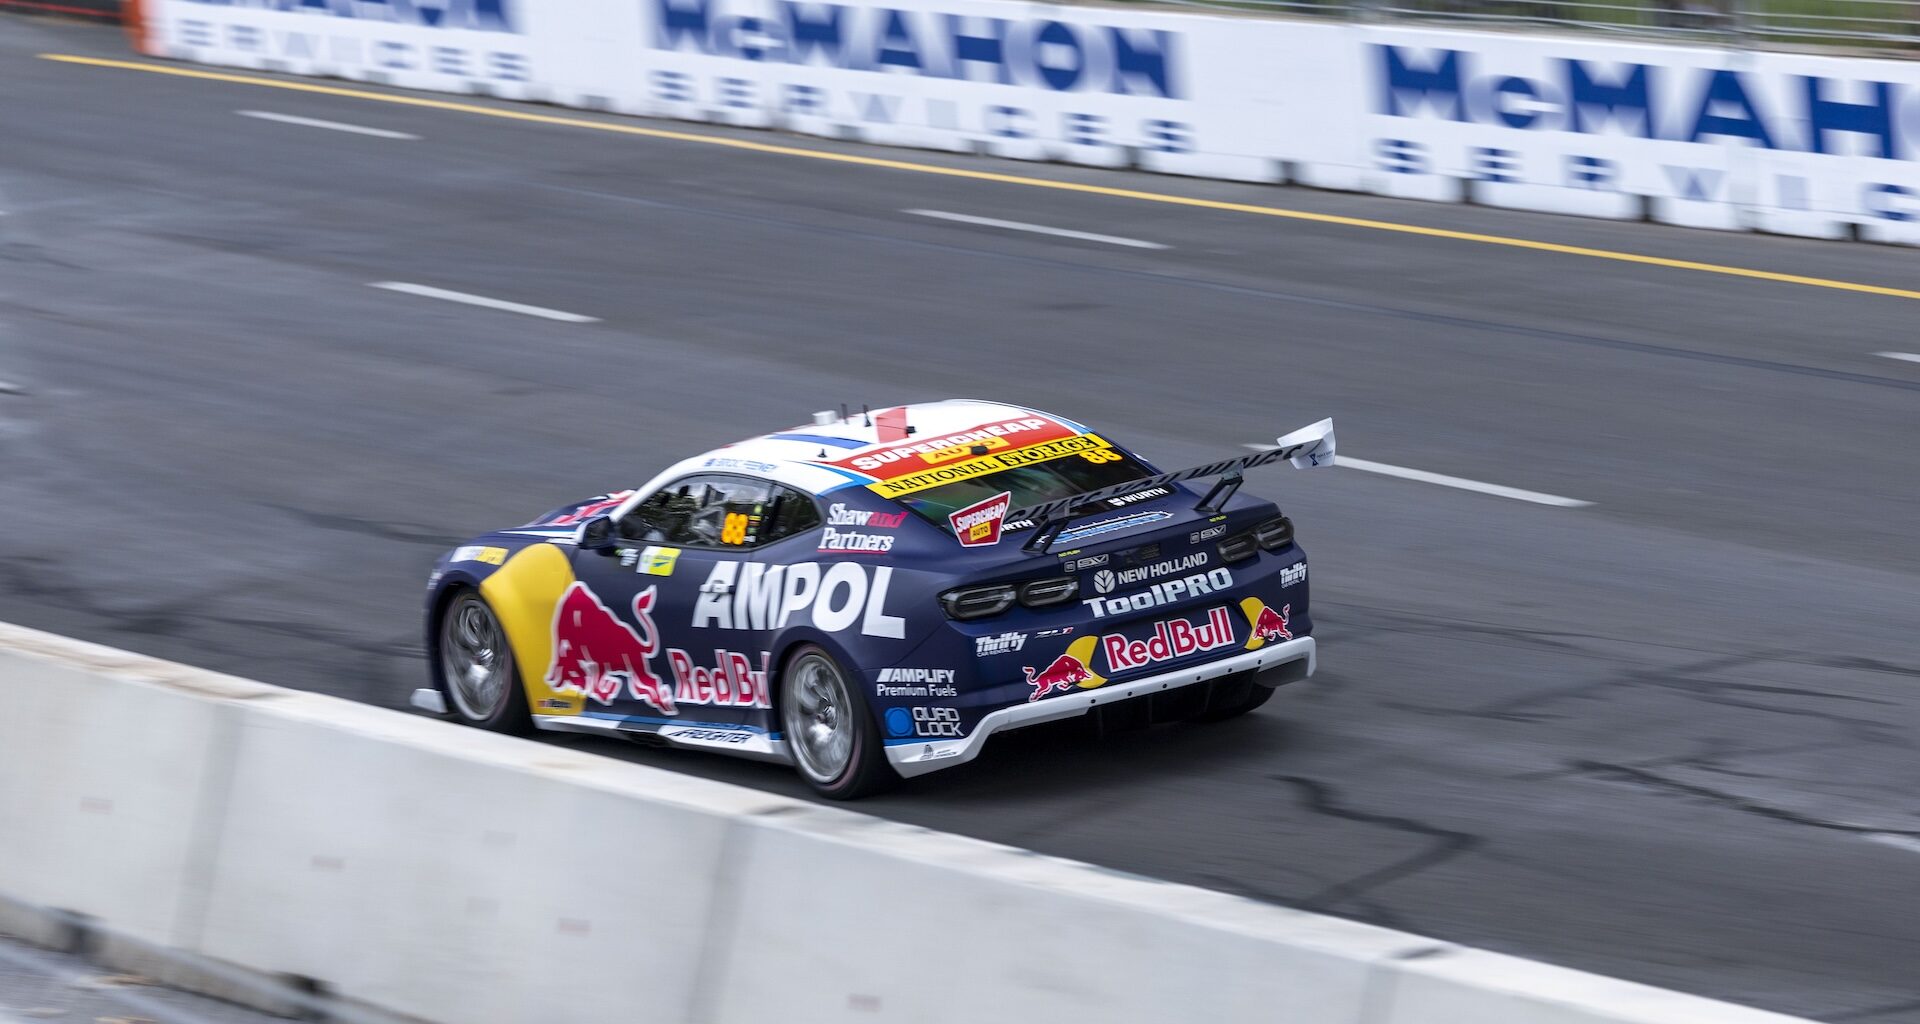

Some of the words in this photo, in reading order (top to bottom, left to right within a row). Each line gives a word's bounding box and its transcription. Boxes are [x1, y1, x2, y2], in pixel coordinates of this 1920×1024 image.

[648, 69, 1197, 154] SERVICES
[851, 418, 1047, 471] SUPERCHEAP
[1078, 448, 1124, 465] 88
[884, 461, 998, 493] NATIONAL
[1001, 437, 1095, 466] STORAGE
[827, 502, 874, 526] Shaw
[956, 502, 1006, 533] SUPERCHEAP
[721, 512, 749, 545] 88
[817, 527, 895, 551] Partners
[972, 526, 989, 537] AUTO
[1117, 566, 1149, 585] NEW
[1149, 552, 1208, 578] HOLLAND
[1280, 562, 1307, 584] Thrifty
[691, 561, 906, 639] AMPOL
[1082, 567, 1234, 618] ToolPRO
[975, 632, 1028, 652] Thrifty
[1102, 621, 1174, 673] Red
[1167, 606, 1236, 658] Bull
[665, 648, 734, 706] Red
[890, 668, 956, 684] AMPLIFY
[876, 683, 928, 697] Premium
[928, 684, 958, 697] Fuels
[912, 706, 961, 721] QUAD
[915, 721, 965, 736] LOCK
